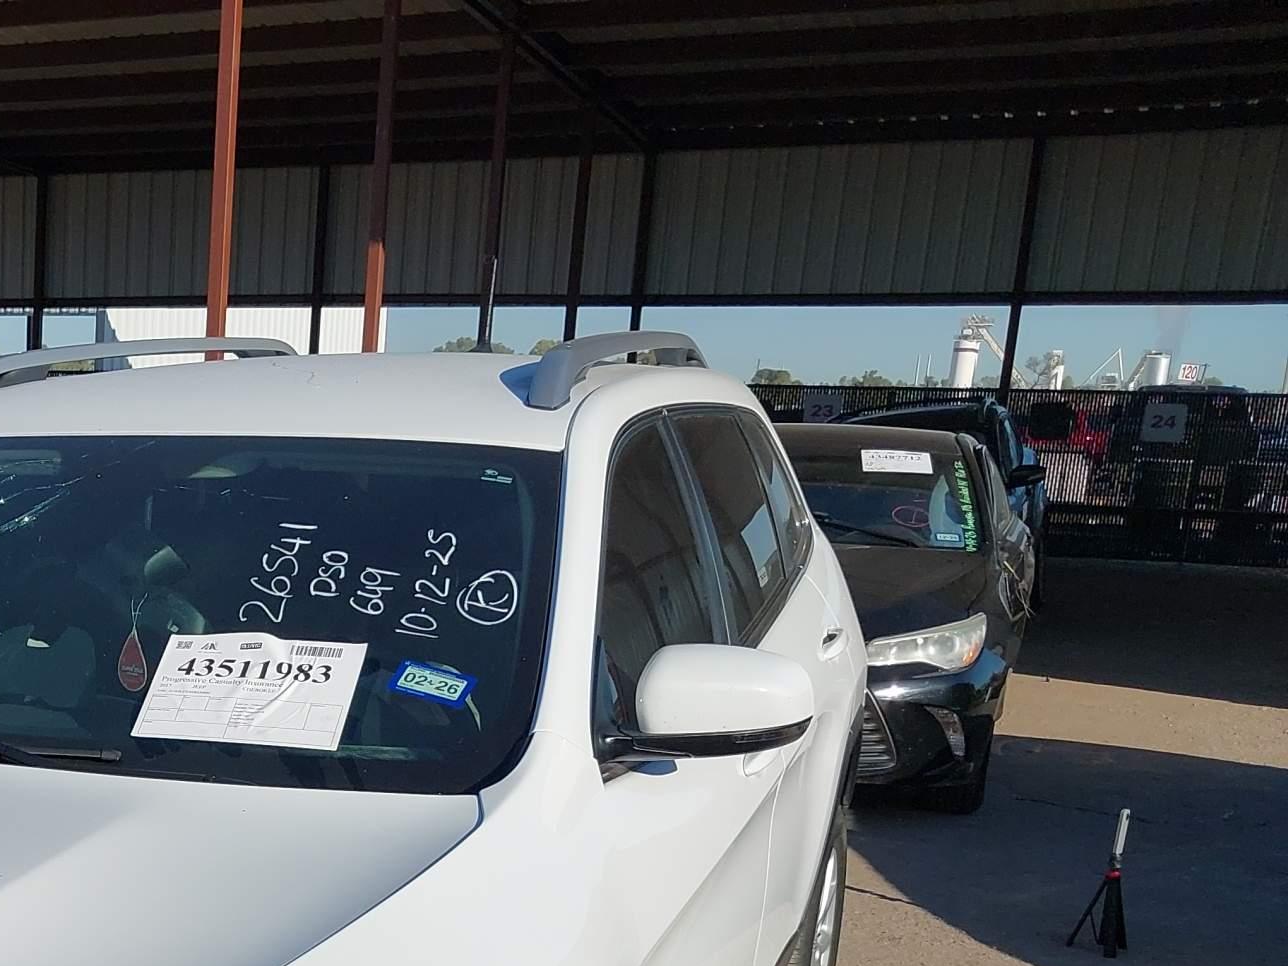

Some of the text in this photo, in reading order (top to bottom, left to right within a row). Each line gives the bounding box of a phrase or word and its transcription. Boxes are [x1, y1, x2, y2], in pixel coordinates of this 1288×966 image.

[1180, 364, 1198, 380] 120
[810, 403, 834, 418] 23
[1150, 414, 1177, 430] 24
[349, 566, 401, 616] 649
[177, 657, 333, 684] 43511983
[161, 675, 285, 688] Progressive Casualty Insurance
